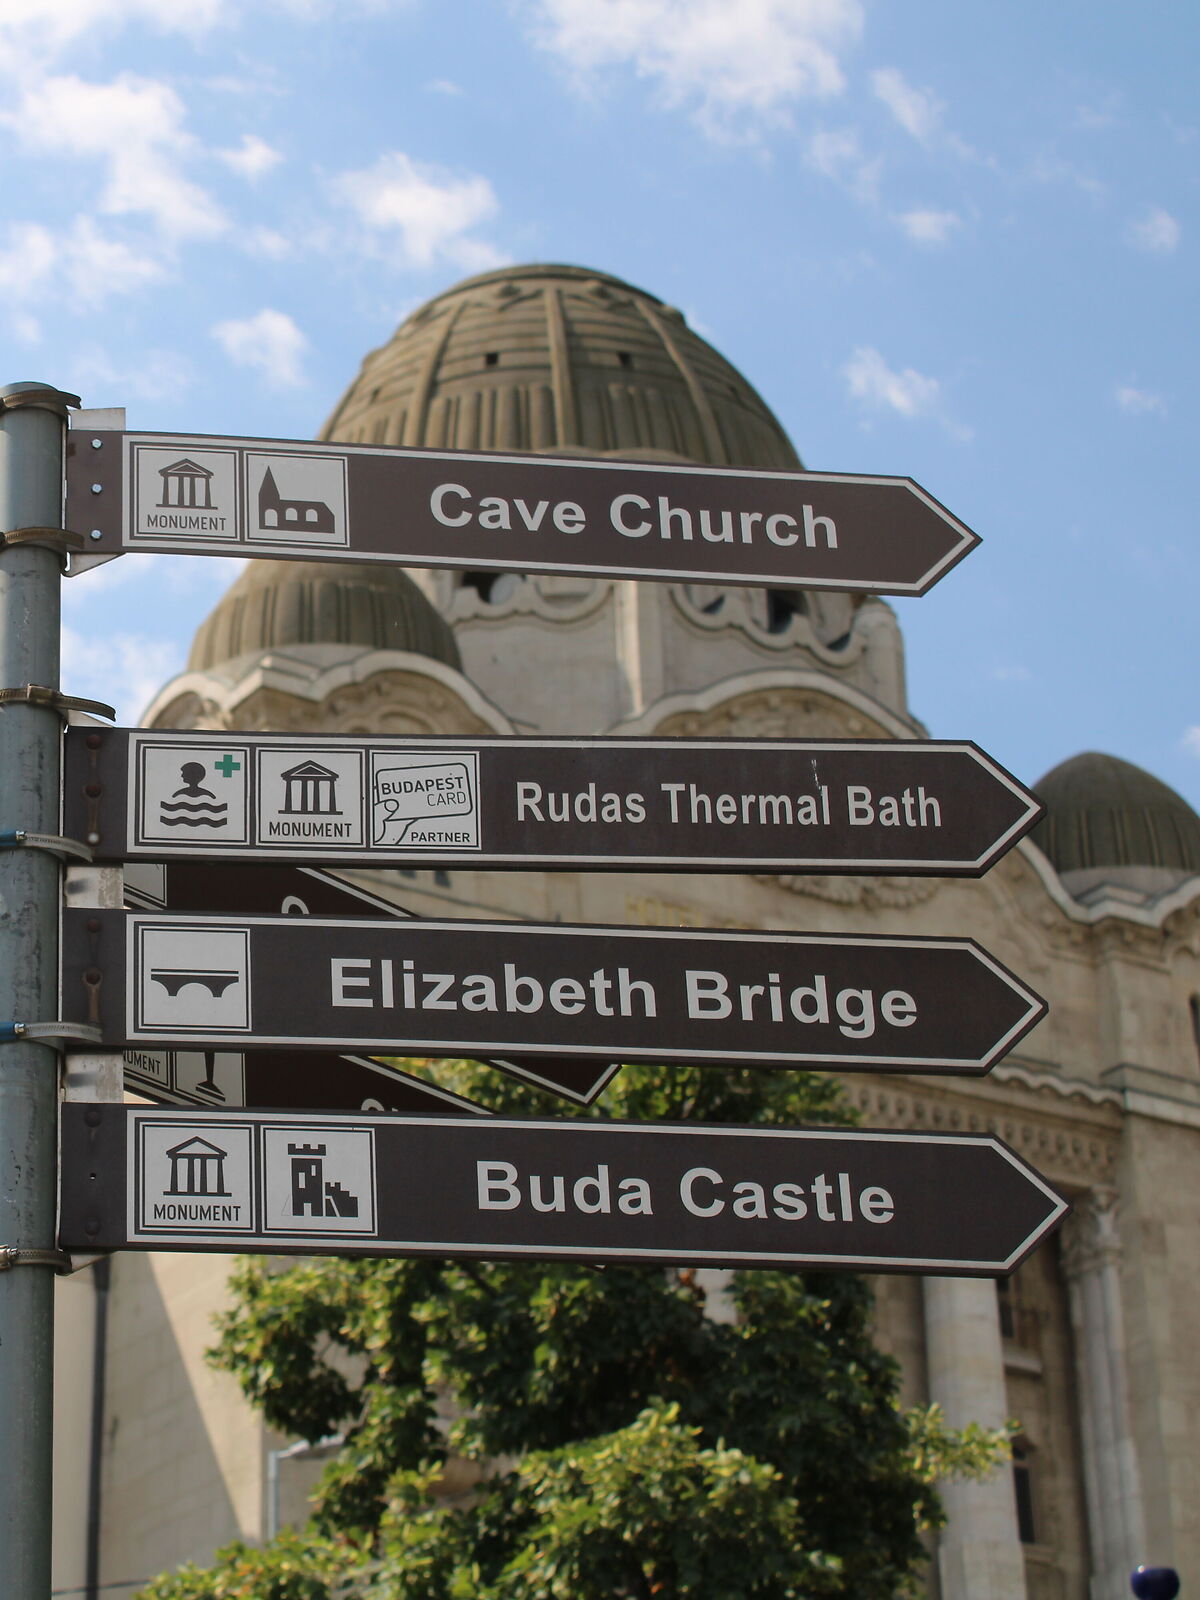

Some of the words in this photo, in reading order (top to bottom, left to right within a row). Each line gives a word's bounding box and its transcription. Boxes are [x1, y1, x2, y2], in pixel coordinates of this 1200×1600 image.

[147, 513, 228, 531] MONUMENT
[430, 483, 586, 535] Cave
[609, 493, 838, 549] Church
[381, 776, 464, 796] BUDAPEST
[426, 791, 467, 807] CARD
[516, 781, 646, 824] Rudas
[660, 783, 831, 826] Thermal
[846, 785, 942, 827] Bath
[269, 821, 353, 838] MONUMENT
[410, 831, 471, 843] PARTNER
[330, 957, 657, 1018] Elizabeth
[685, 968, 917, 1039] Bridge
[476, 1160, 654, 1215] Buda
[679, 1167, 895, 1224] Castle
[153, 1203, 242, 1222] MONUMENT
